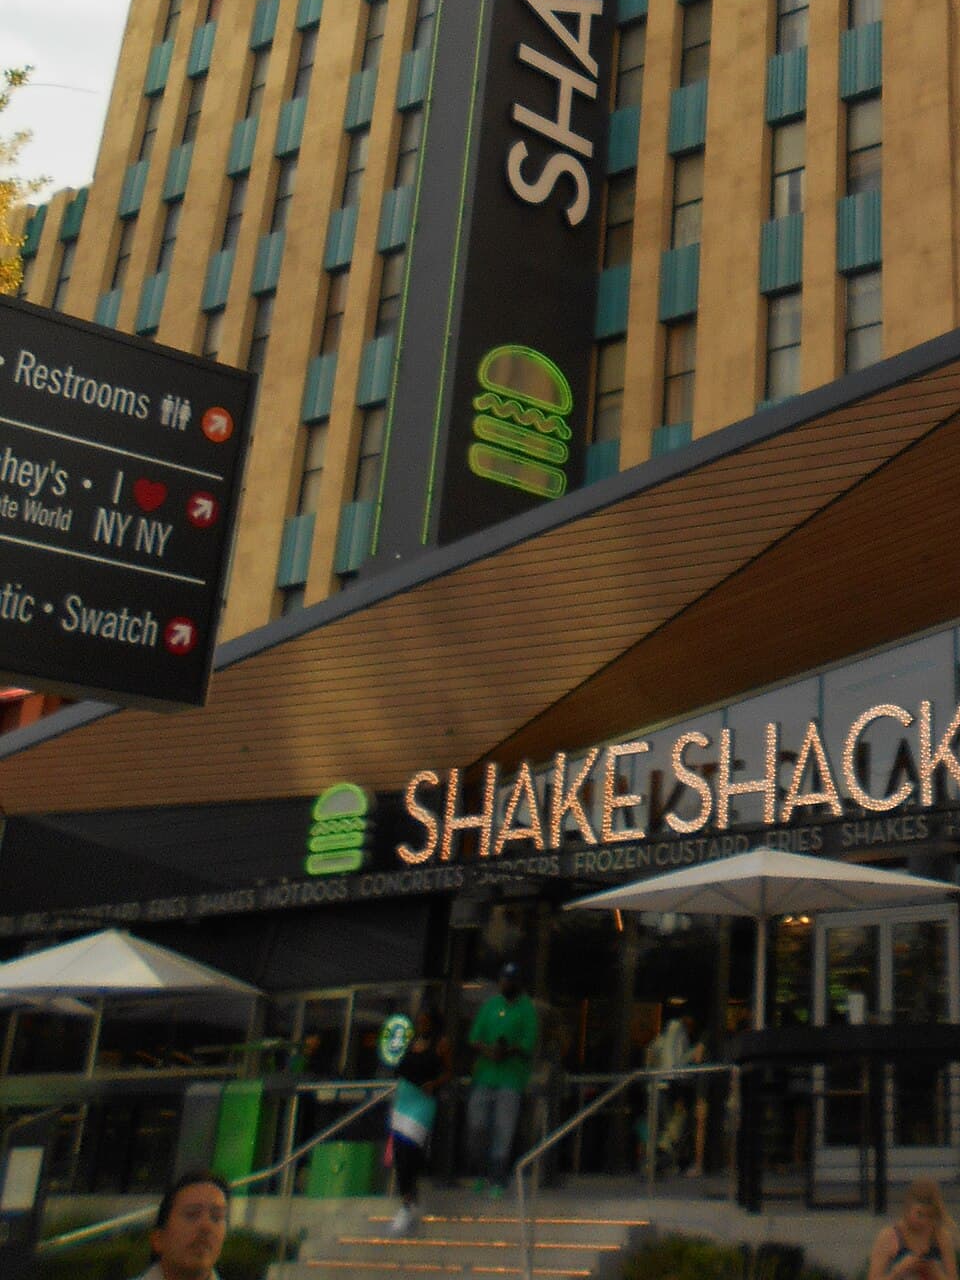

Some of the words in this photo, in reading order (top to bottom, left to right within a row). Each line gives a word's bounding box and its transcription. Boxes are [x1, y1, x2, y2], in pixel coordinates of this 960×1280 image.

[14, 350, 150, 420] Restrooms
[0, 447, 68, 497] hey's
[112, 470, 124, 505] I
[0, 494, 18, 519] te
[24, 499, 73, 532] World
[93, 507, 133, 547] NY
[134, 521, 173, 558] NY
[0, 582, 36, 623] tic
[62, 593, 159, 648] Swatch
[396, 740, 650, 865] SHAKE
[360, 866, 464, 896] CONCRETES
[575, 842, 652, 875] FROZEN
[655, 834, 750, 866] CUSTARD
[766, 826, 825, 852] FRIES
[841, 816, 928, 847] SHAKES
